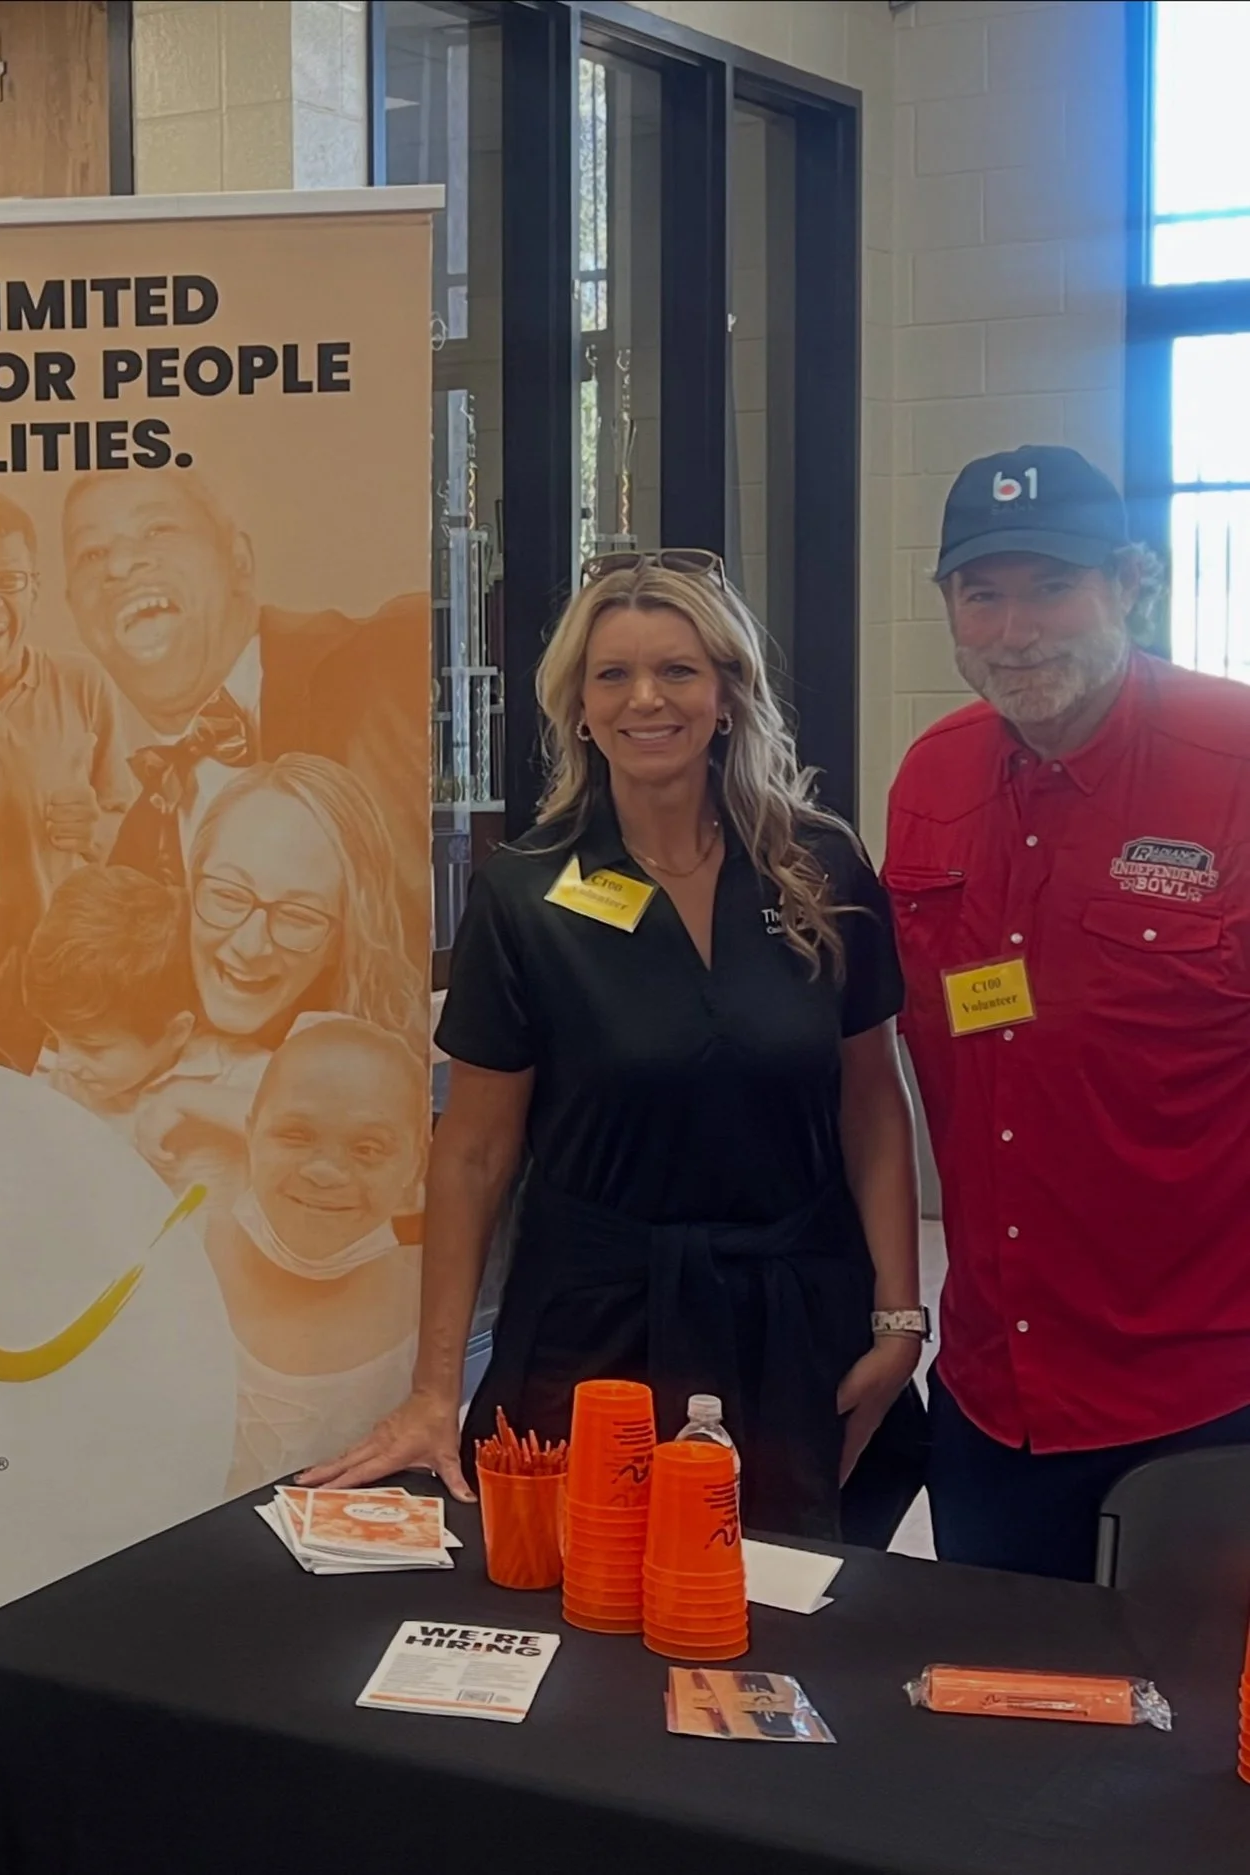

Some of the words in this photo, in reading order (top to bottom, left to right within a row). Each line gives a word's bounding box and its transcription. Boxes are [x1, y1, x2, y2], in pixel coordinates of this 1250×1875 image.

[102, 342, 351, 400] PEOPLE
[1112, 859, 1219, 889] INDEPENDENCE
[1135, 876, 1188, 897] BOWL
[405, 1635, 542, 1657] HIRING
[419, 1625, 541, 1647] WE'RE
